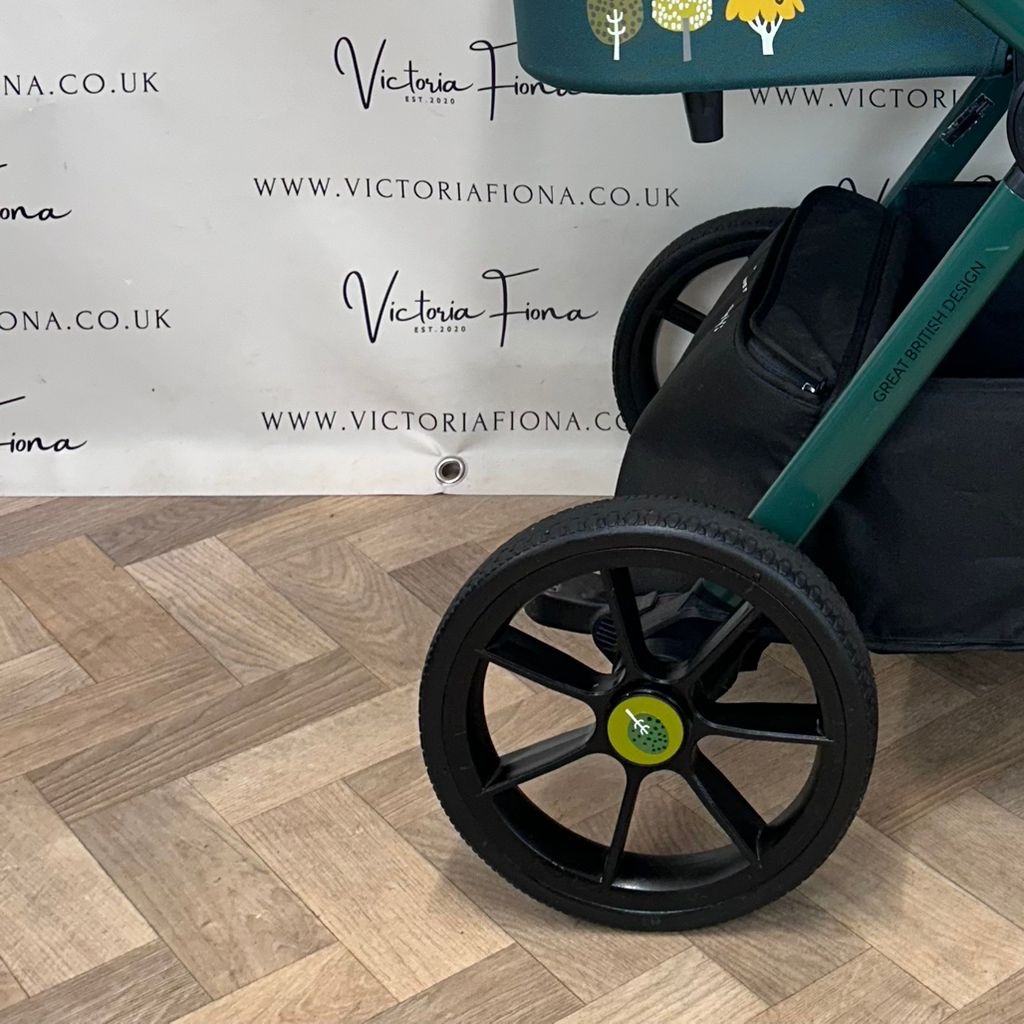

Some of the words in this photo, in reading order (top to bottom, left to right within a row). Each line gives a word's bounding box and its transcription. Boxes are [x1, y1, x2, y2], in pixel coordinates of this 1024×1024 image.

[334, 37, 474, 109] Victoria
[404, 96, 456, 105] EST.2020
[254, 177, 681, 207] WWW.VICTORIAFIONA.CO.UK
[343, 271, 486, 344] Victoria
[481, 268, 599, 347] Fiona
[413, 325, 467, 334] EST.2020
[873, 358, 910, 403] GREAT
[904, 310, 948, 361] BRITISH
[942, 260, 986, 313] DESIGN
